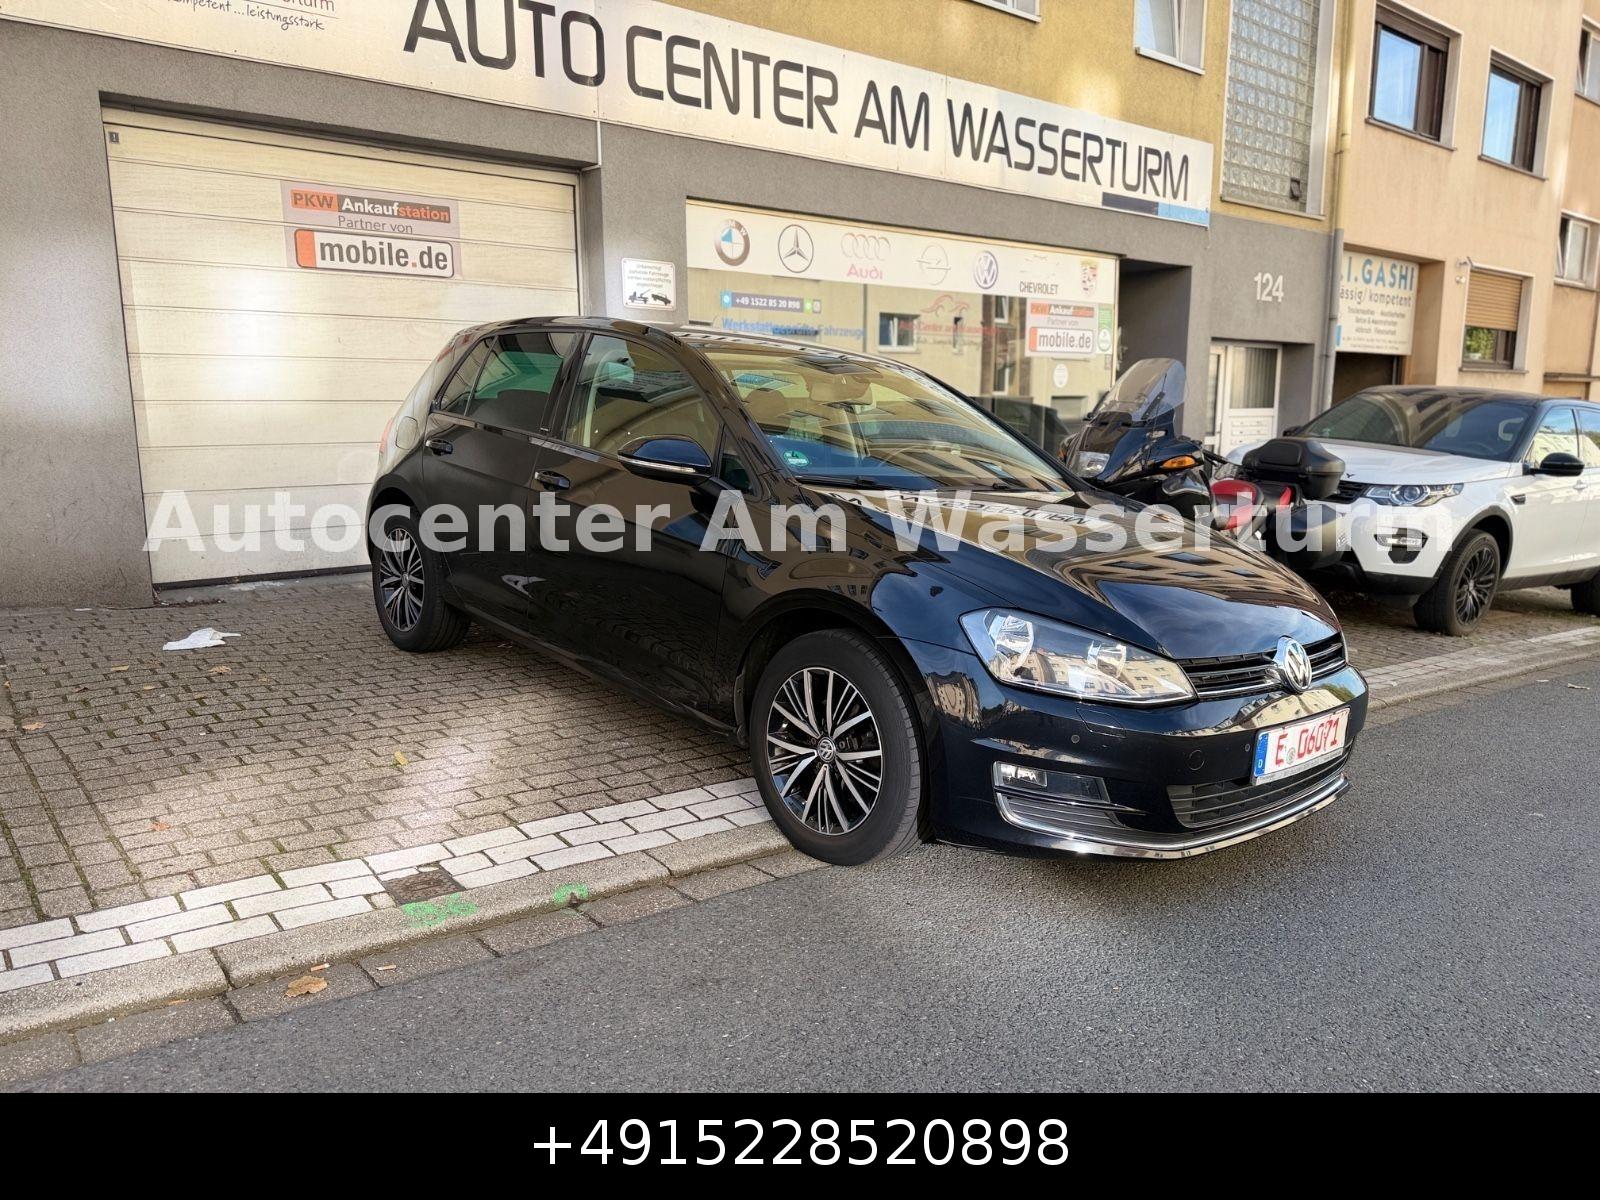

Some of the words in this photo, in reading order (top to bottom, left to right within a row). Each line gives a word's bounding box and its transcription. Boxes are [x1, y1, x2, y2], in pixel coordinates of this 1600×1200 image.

[403, 0, 605, 88] AUTO
[626, 25, 838, 134] CENTER
[854, 80, 930, 151] AM
[946, 98, 1190, 200] WASSERTURM
[293, 192, 334, 209] PKW
[341, 197, 450, 222] Ankaufstation
[338, 215, 387, 232] Partner
[390, 224, 414, 235] von
[320, 240, 449, 271] mobile.de
[847, 264, 883, 281] Audi
[1254, 271, 1284, 302] 124
[1020, 281, 1059, 295] CHEVROLET
[1039, 332, 1092, 349] mobile.de
[1275, 733, 1288, 766] E
